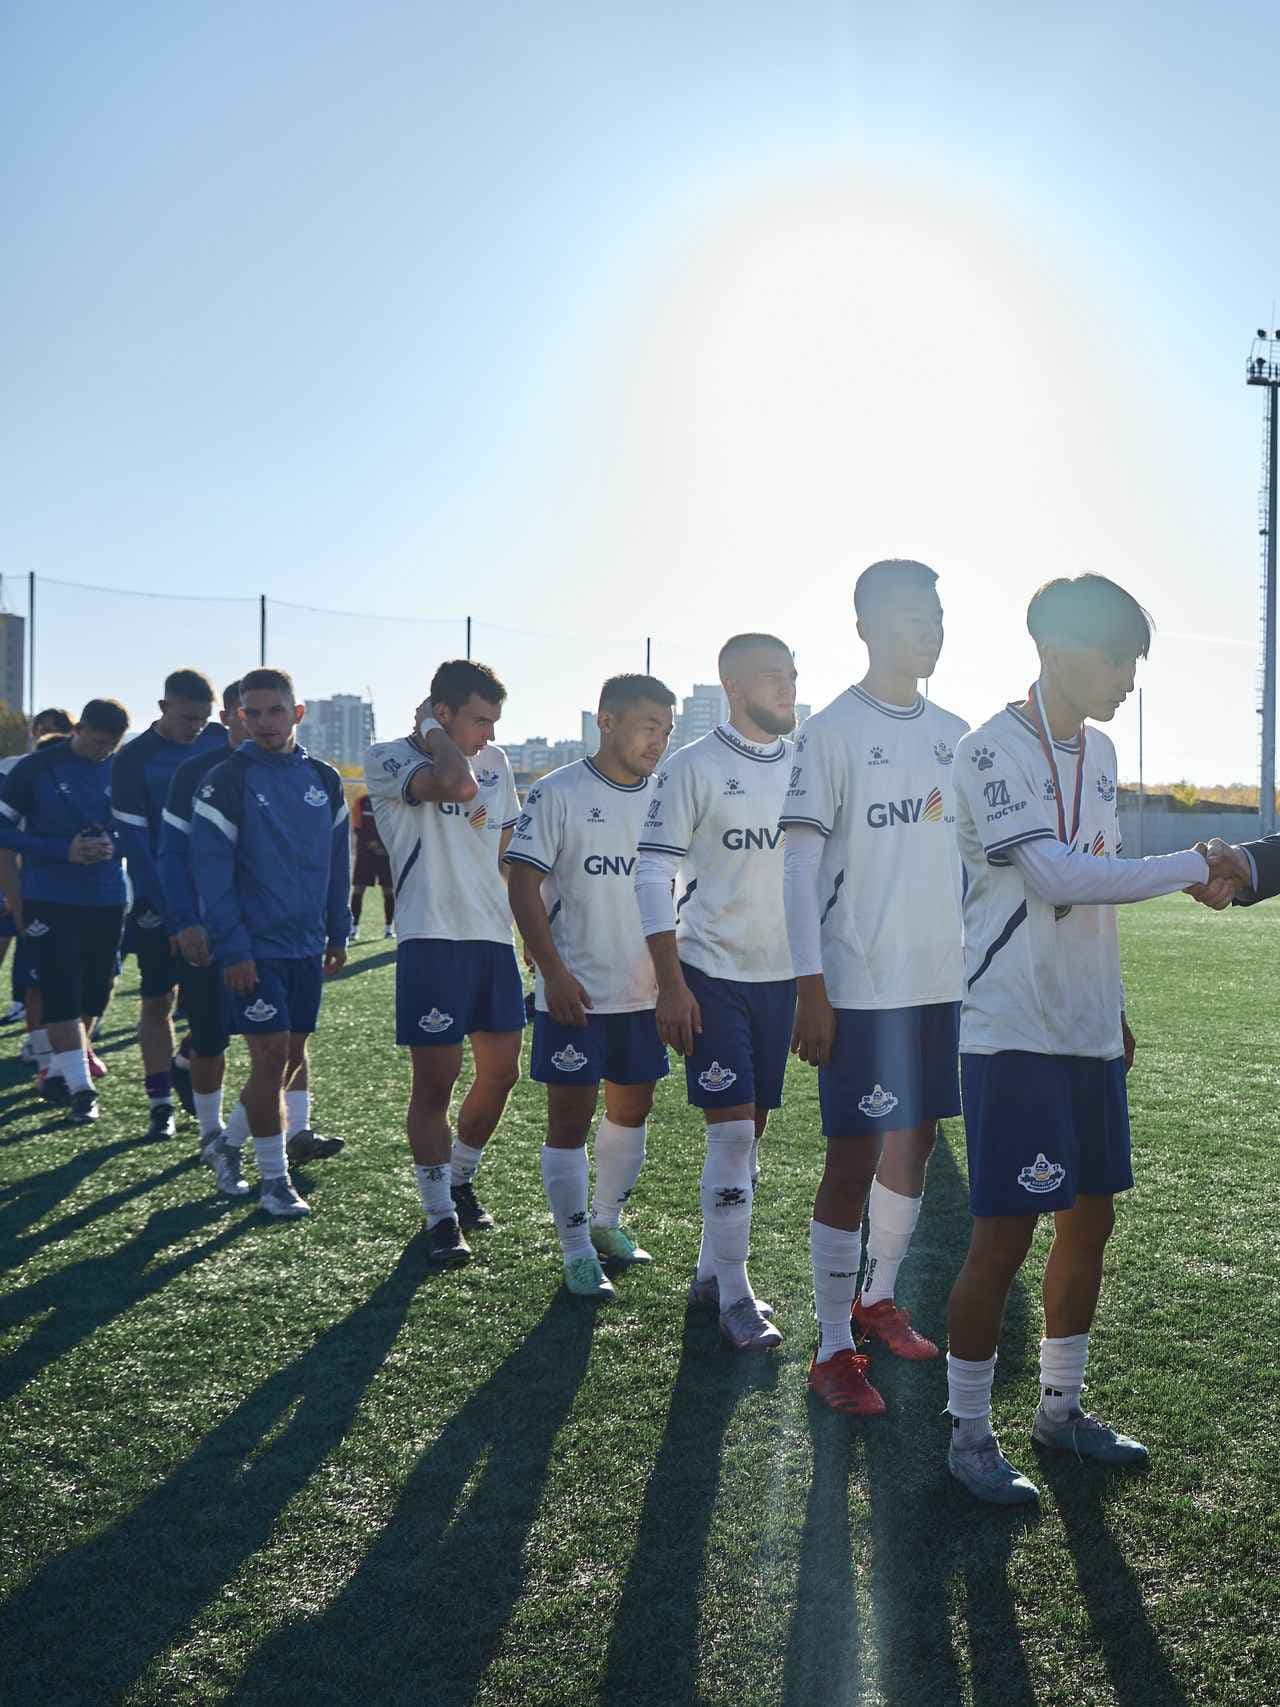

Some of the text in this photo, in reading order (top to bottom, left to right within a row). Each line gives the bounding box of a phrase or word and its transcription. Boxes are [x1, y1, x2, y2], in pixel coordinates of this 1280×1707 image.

[866, 798, 923, 829] GNV
[986, 800, 1028, 824] ПОСТЕР
[721, 827, 782, 851] GNV
[583, 855, 636, 876] GNV
